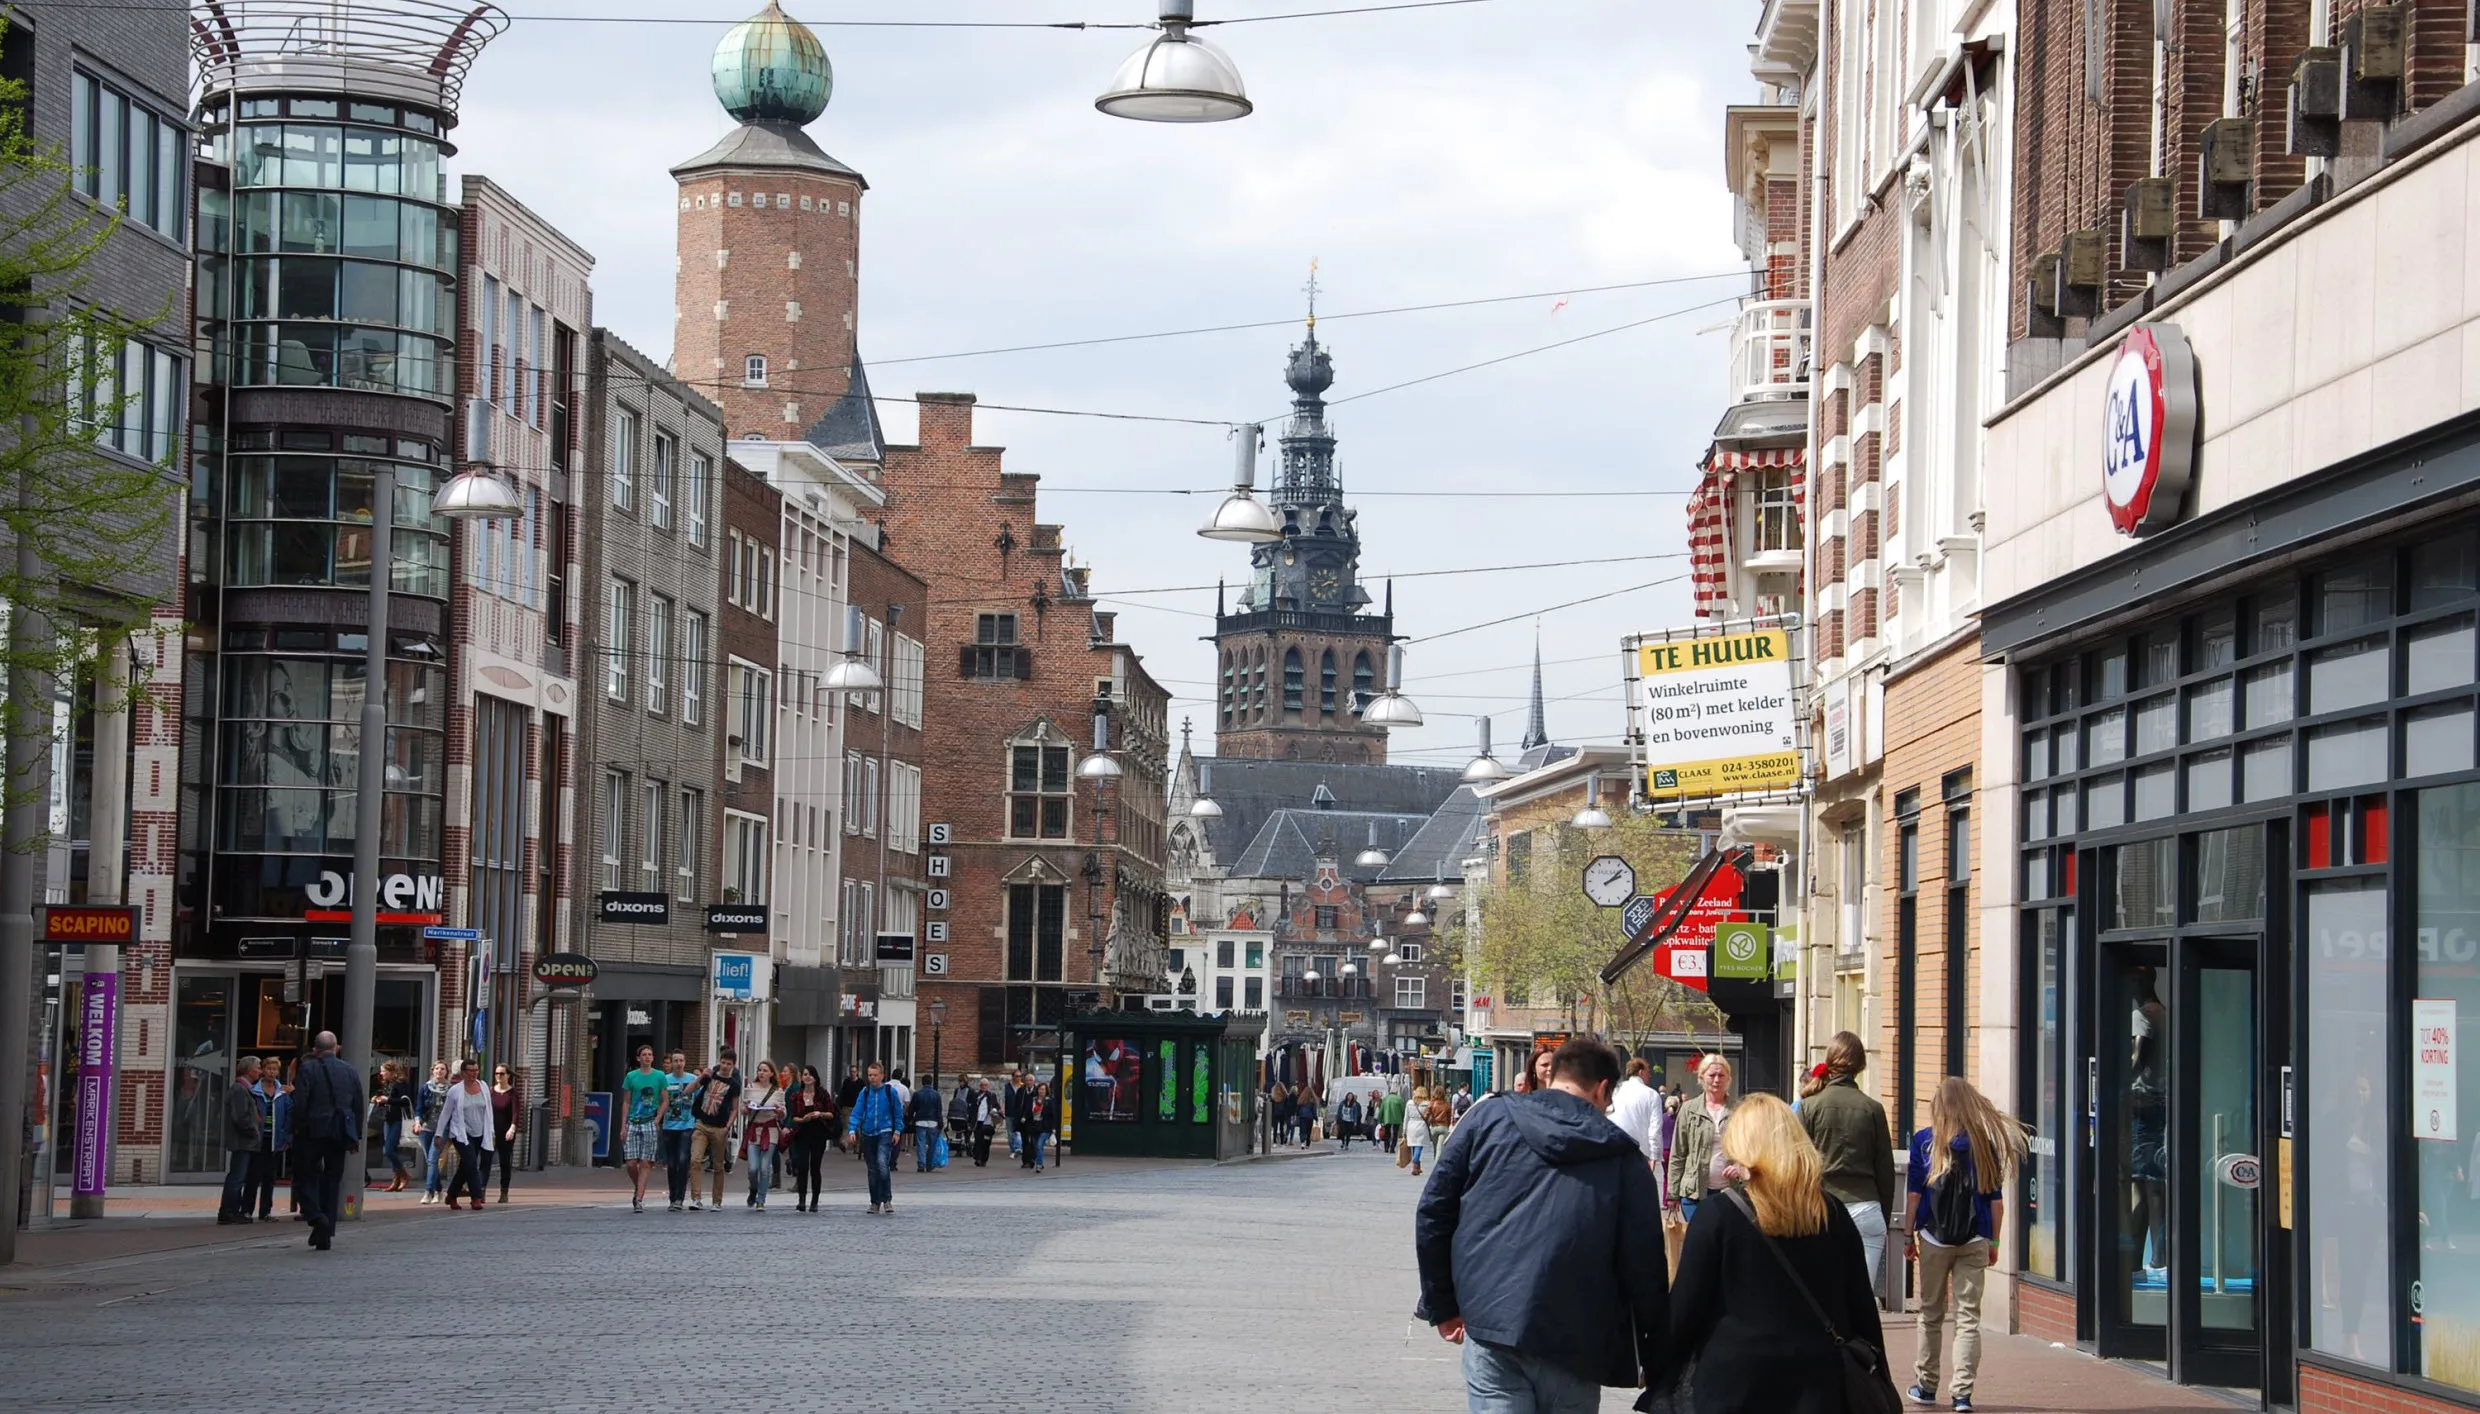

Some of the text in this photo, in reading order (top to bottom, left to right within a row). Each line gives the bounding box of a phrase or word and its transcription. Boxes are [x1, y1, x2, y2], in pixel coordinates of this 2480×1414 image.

[2107, 378, 2145, 477] C&A
[1650, 636, 1774, 670] TE HUUR
[1649, 678, 1748, 699] Winkelruimte
[1706, 701, 1734, 716] met
[1738, 695, 1785, 712] kelder
[1652, 719, 1774, 744] en bovenwoning
[1678, 757, 1794, 780] CLAASE 024-3580201
[1723, 767, 1796, 783] www.claase.nl
[605, 901, 665, 914] dixons
[929, 826, 945, 972] SHOES
[1697, 897, 1732, 907] Zeeland
[49, 915, 130, 934] SCAPINO
[711, 912, 764, 924] dixons
[722, 962, 749, 977] lief!
[86, 992, 105, 1066] WELKOM
[2420, 1027, 2449, 1045] TOT 40%
[2421, 1049, 2449, 1065] KORTING
[82, 1080, 97, 1186] MARIKENSTRAAT
